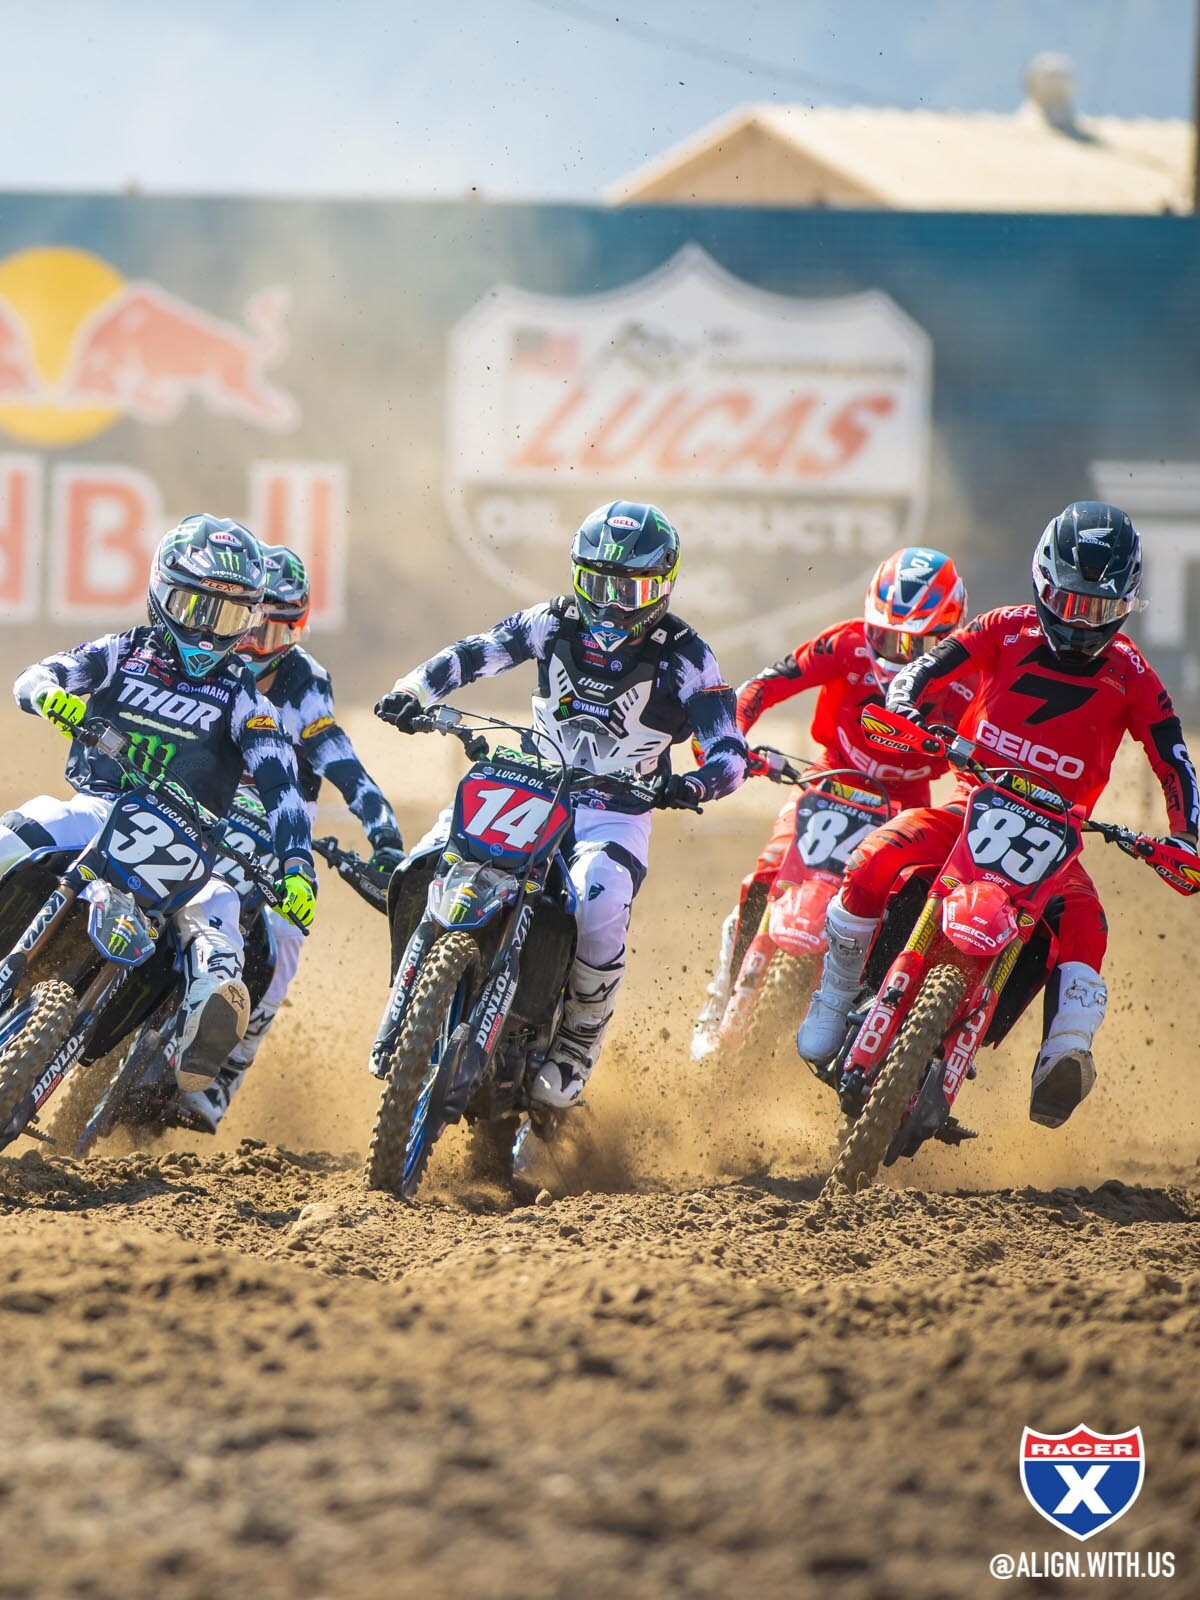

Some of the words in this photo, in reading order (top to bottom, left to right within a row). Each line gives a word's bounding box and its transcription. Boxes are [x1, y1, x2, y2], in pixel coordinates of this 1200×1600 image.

[513, 387, 895, 479] LUCAS
[612, 518, 637, 529] BELL
[54, 465, 343, 622] Bll
[215, 534, 238, 545] BELL
[1077, 537, 1111, 549] HONDA
[199, 578, 234, 593] FLEX
[1002, 606, 1038, 620] GEIC
[673, 627, 690, 642] thor
[1112, 640, 1145, 674] GEICO
[577, 676, 615, 694] thor
[115, 677, 223, 731] THOR
[580, 702, 611, 718] YAMAHA
[869, 734, 911, 753] CYCRA
[974, 718, 1086, 781] GEICO
[495, 769, 526, 784] LUCAS
[527, 778, 545, 790] OIL
[157, 803, 187, 828] LUCAS
[184, 826, 199, 841] OIL
[464, 786, 554, 849] 14
[828, 801, 858, 817] LUCAS
[857, 811, 873, 822] OIL
[1004, 800, 1036, 819] LUCAS
[1035, 814, 1052, 828] OIL
[230, 812, 260, 832] LUCAS
[257, 829, 273, 842] OIL
[108, 811, 205, 900] 32
[967, 807, 1066, 886] 83
[981, 871, 1011, 889] SHIFT
[948, 921, 998, 949] GEICO
[952, 931, 987, 951] HONDA
[859, 970, 911, 1054] GICO
[942, 1008, 987, 1095] GEICO
